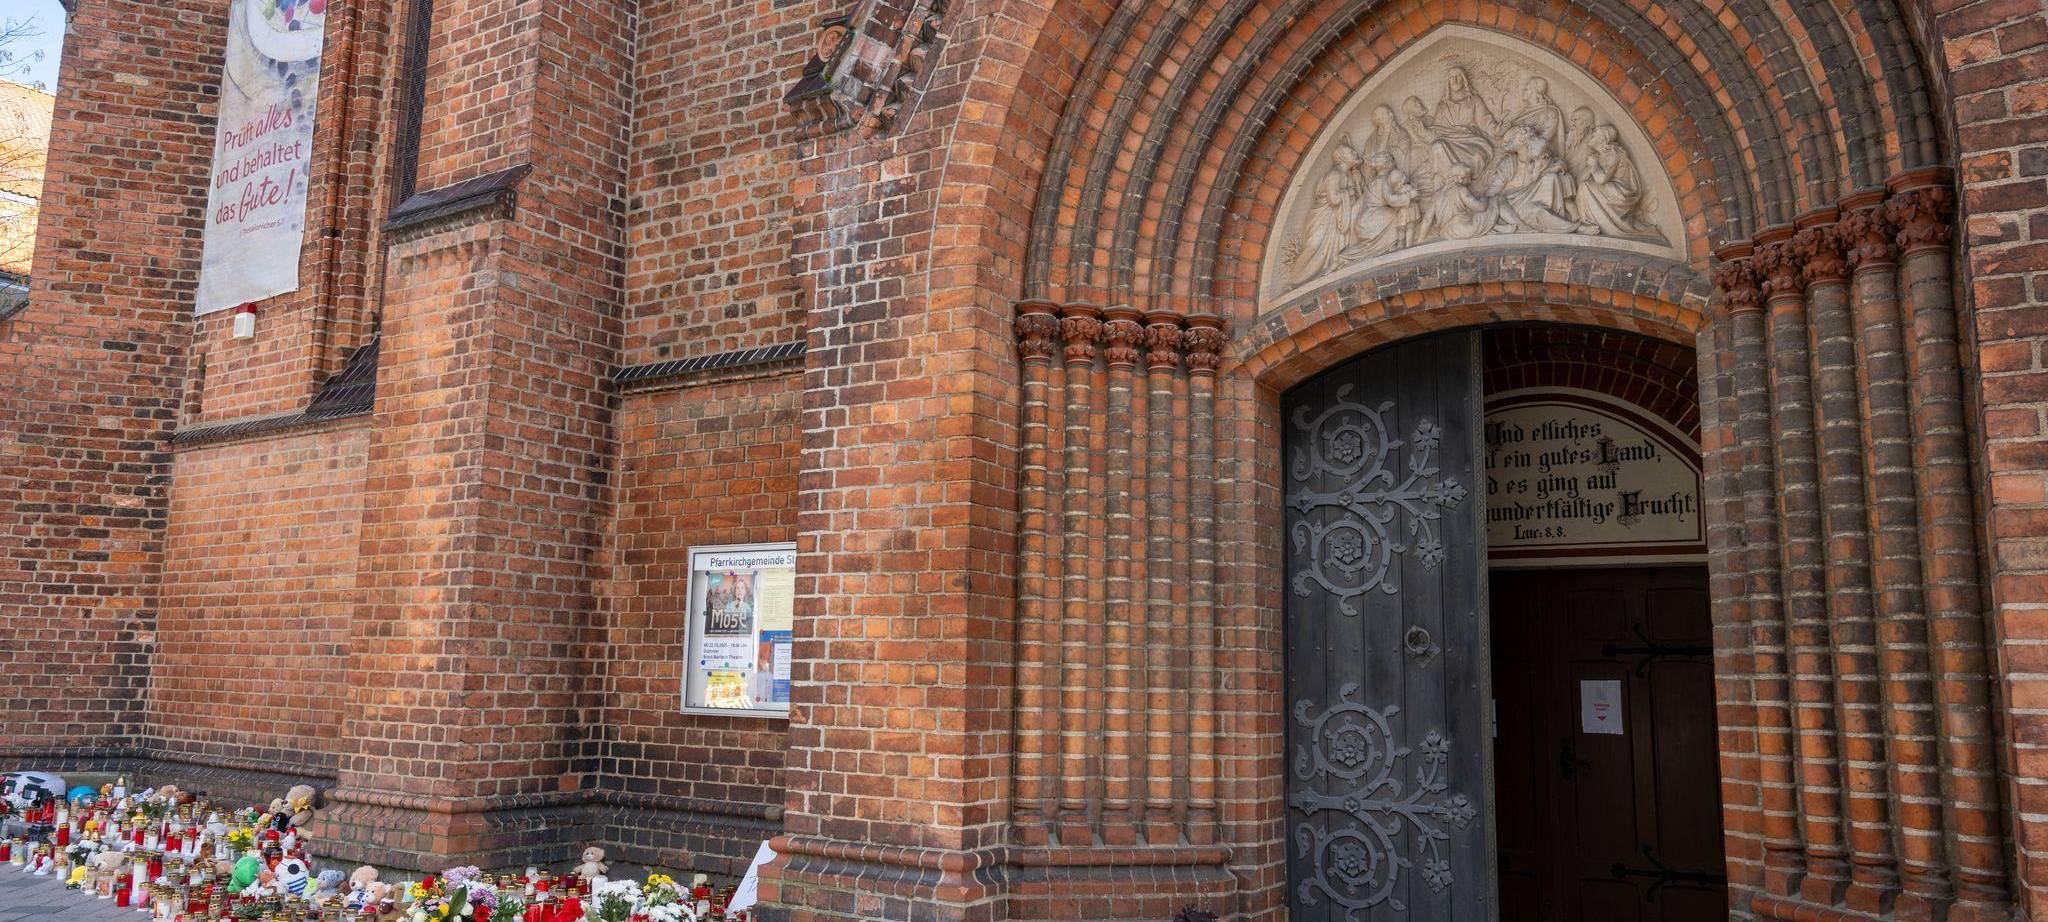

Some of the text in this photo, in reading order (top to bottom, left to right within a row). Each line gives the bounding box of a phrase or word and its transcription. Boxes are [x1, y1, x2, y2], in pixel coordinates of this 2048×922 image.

[223, 103, 292, 152] Prüft alles
[216, 140, 301, 189] und behaltet
[216, 168, 295, 224] das Gute!
[1484, 418, 1601, 446] Und etliches
[1504, 451, 1531, 468] ein
[1539, 446, 1590, 473] gutes
[1506, 477, 1528, 494] es
[1537, 474, 1579, 499] ging
[1587, 468, 1620, 490] auf
[1618, 490, 1696, 523] Frucht.
[710, 556, 784, 568] Pfarrkirchgemeinde
[712, 608, 747, 629] Mose
